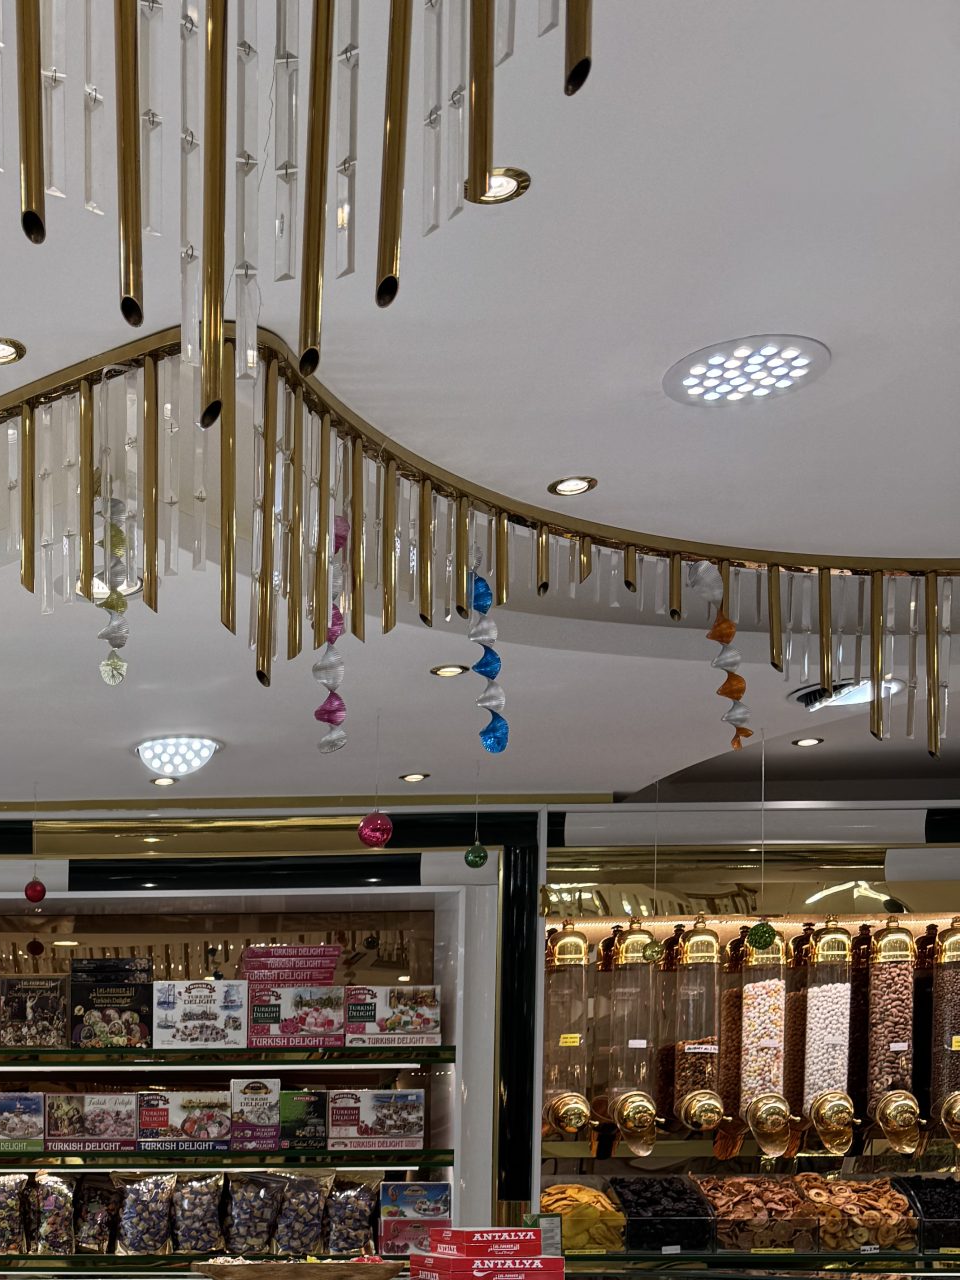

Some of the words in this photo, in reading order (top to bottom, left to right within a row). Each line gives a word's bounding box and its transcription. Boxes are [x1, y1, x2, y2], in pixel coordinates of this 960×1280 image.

[270, 948, 297, 956] TURKISH
[267, 960, 294, 968] TURKISH
[295, 960, 321, 968] DELIGHT
[245, 972, 278, 980] TURKISH
[279, 972, 312, 980] DELIGHT
[251, 1037, 287, 1046] TURKISH
[289, 1037, 324, 1046] DELIGHT
[367, 1037, 396, 1045] TURKISH
[397, 1037, 424, 1045] DELIGHT
[141, 1142, 177, 1150] TURKISH
[178, 1142, 213, 1150] DELIGHT
[472, 1231, 536, 1241] ANTALYA
[471, 1259, 543, 1269] ANTALYA
